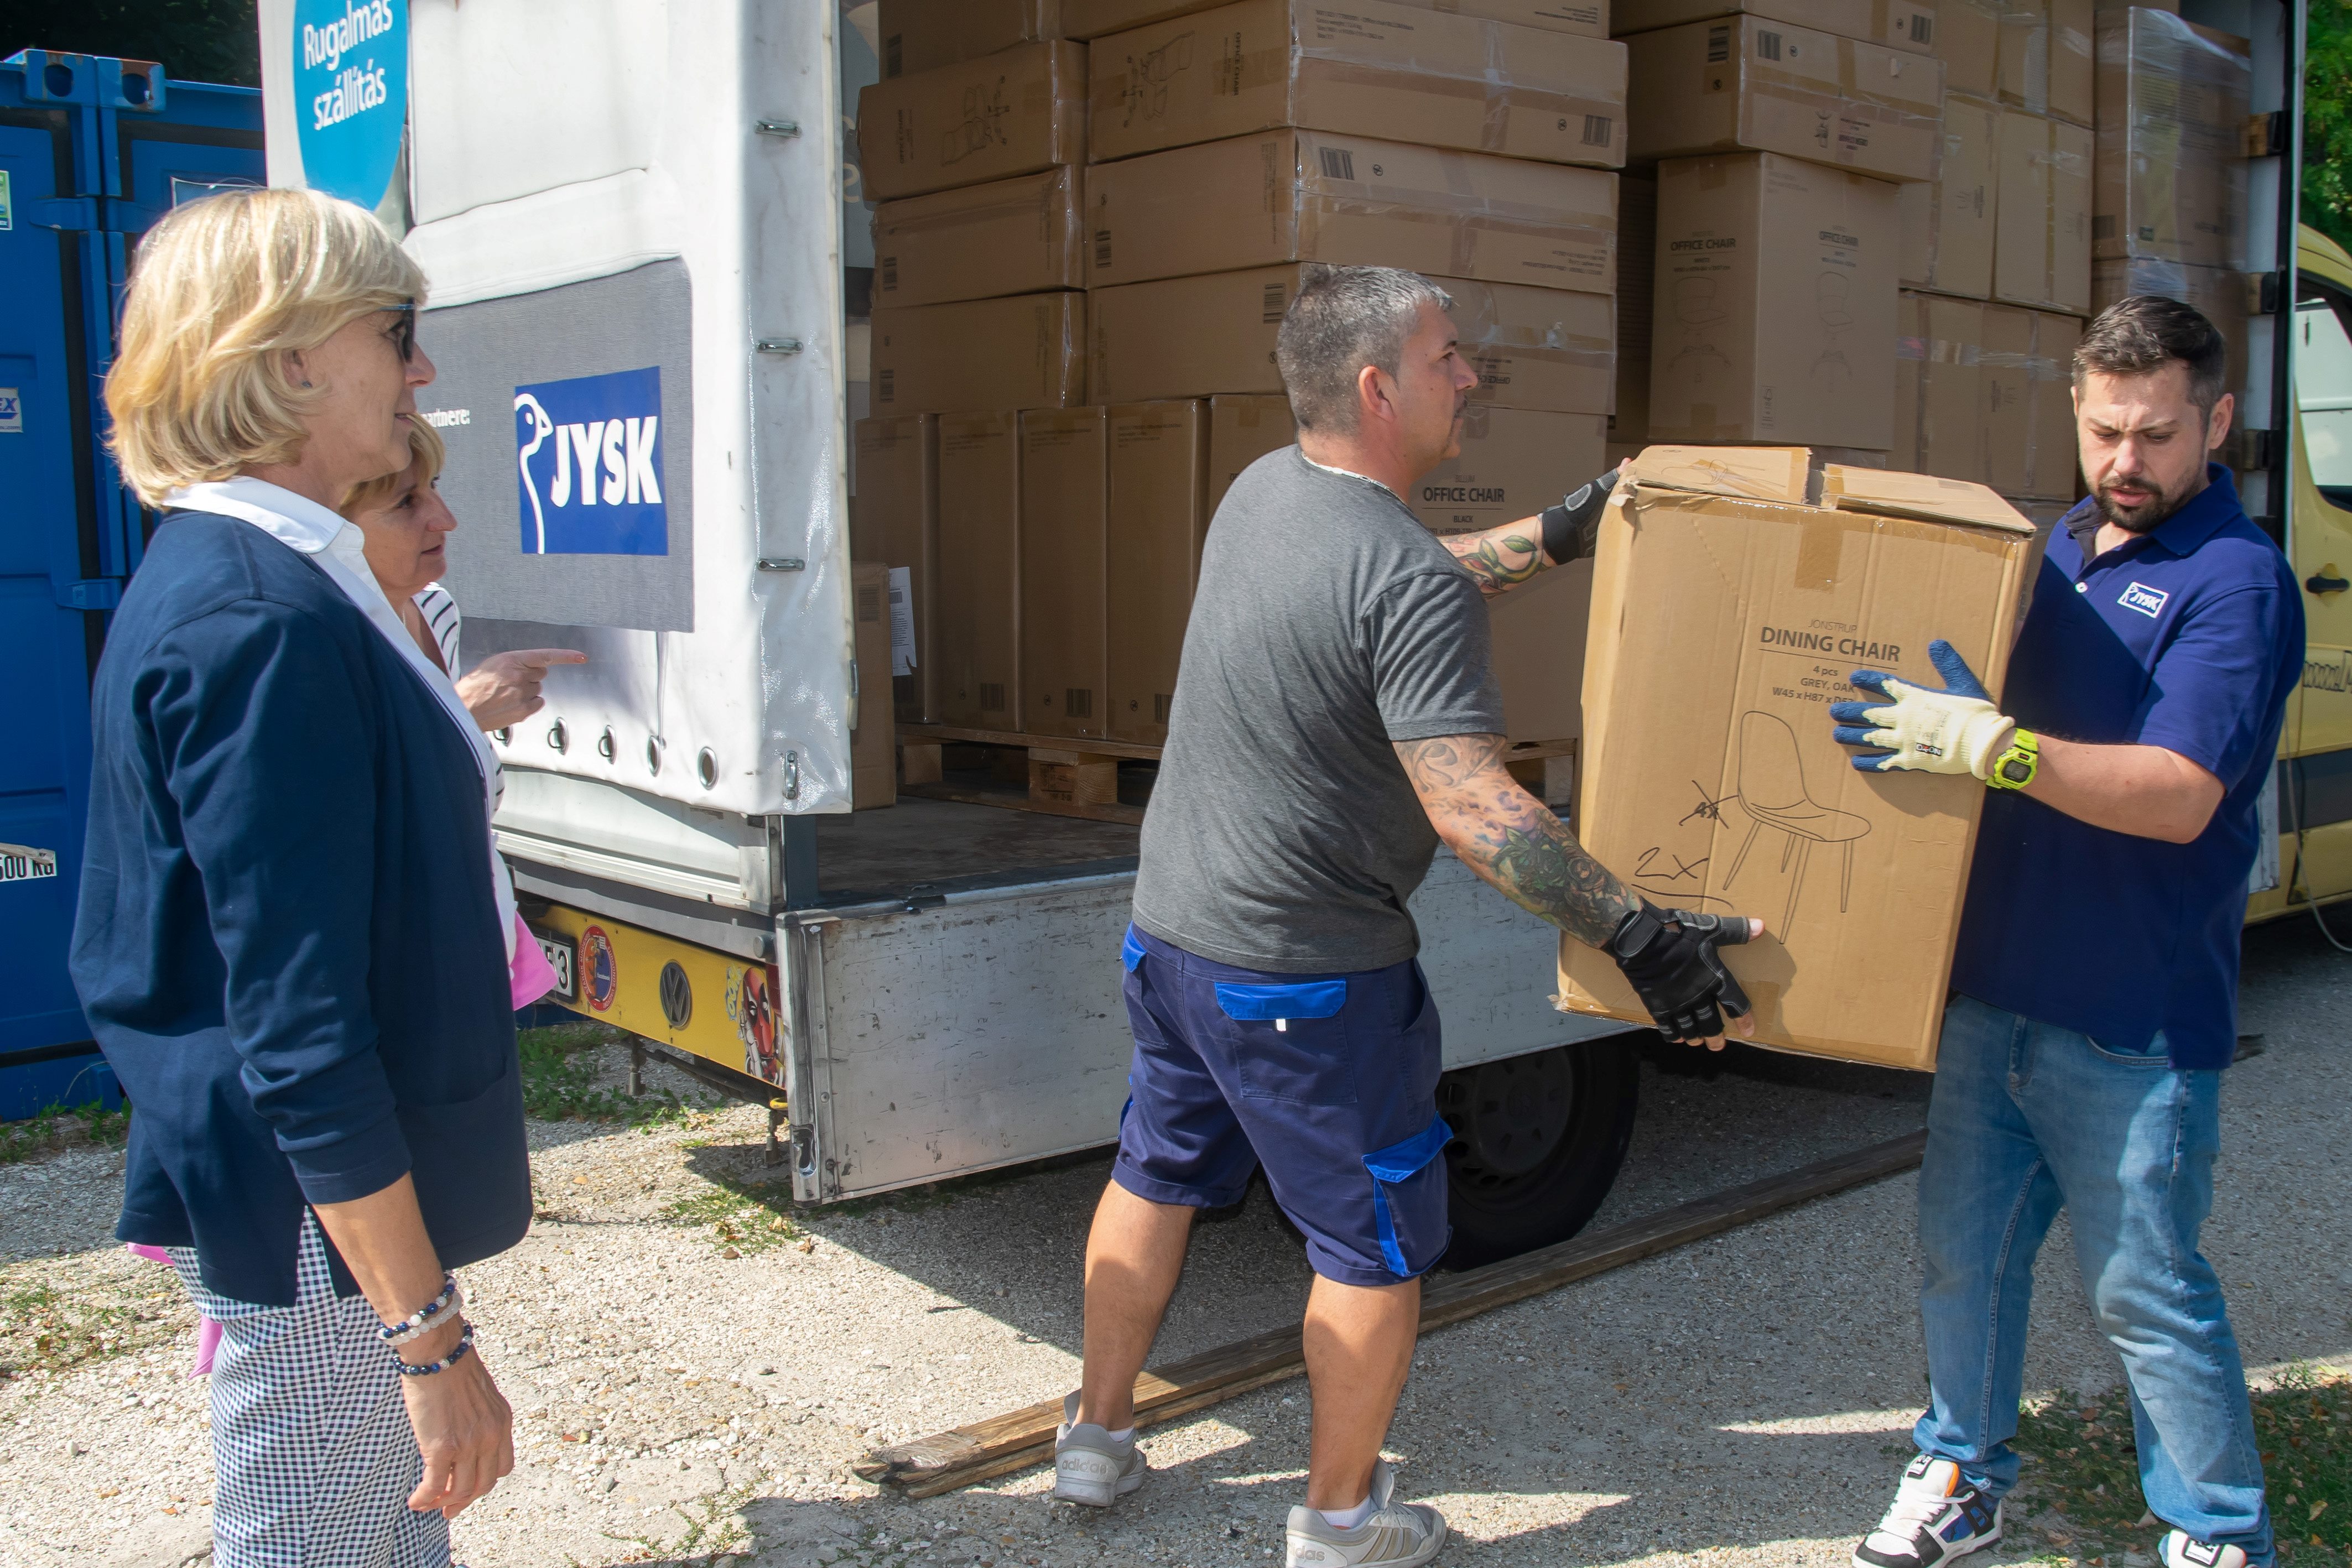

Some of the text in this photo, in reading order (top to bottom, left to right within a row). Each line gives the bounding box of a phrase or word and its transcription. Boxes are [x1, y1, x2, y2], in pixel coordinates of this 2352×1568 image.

[303, 0, 393, 71] Rugalmas
[313, 58, 387, 131] szállítás
[1671, 238, 1736, 251] OFFICE CHAIR
[550, 416, 662, 507] JYSK
[1423, 487, 1505, 502] OFFICE CHAIR
[2130, 591, 2162, 611] JYSK
[1808, 619, 1858, 633] JONSTRUP
[1760, 626, 1901, 663] DINING CHAIR
[1813, 665, 1839, 677] 4 pcs
[1800, 678, 1855, 693] GREY, OAK
[1772, 686, 1794, 698] W45
[1804, 691, 1825, 702] H87
[1061, 1458, 1108, 1475] adidas
